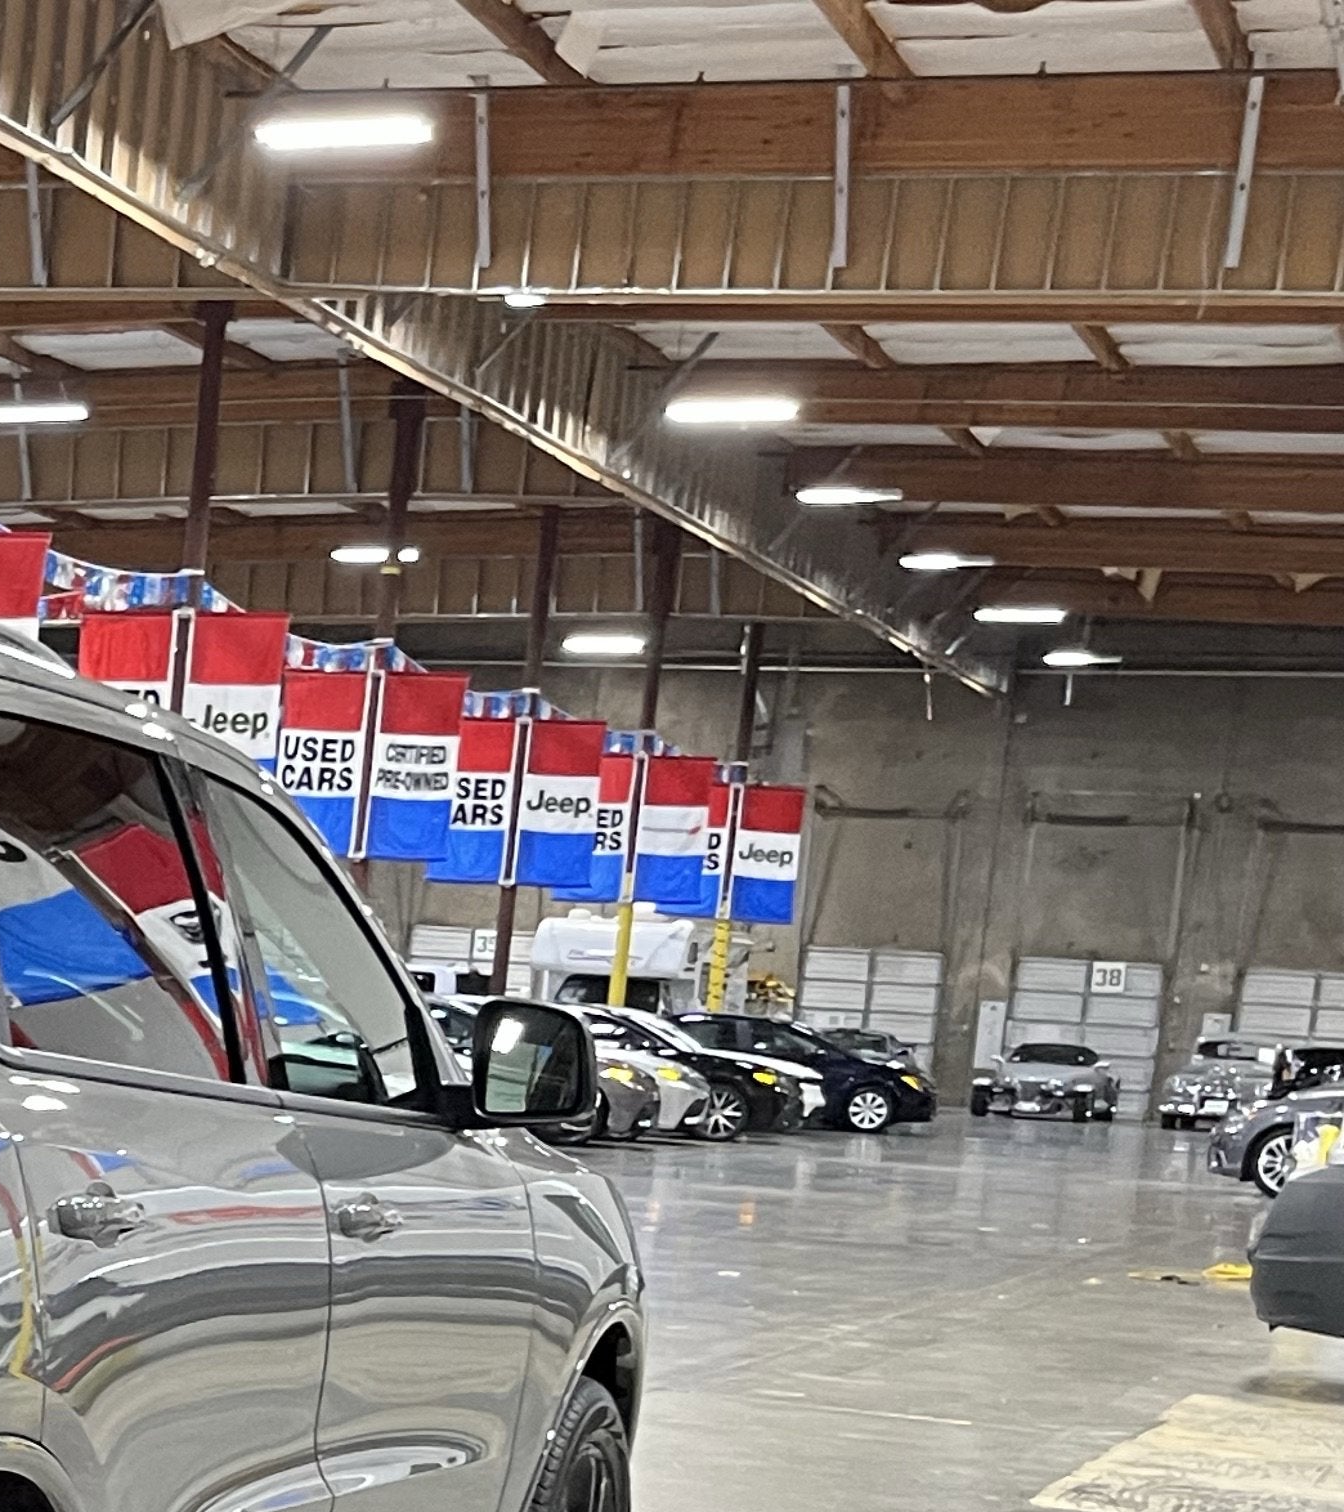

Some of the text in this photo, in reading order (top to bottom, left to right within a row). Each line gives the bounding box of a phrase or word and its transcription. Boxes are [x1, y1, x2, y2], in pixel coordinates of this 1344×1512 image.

[283, 735, 356, 763] USED
[281, 765, 354, 792] CARS
[456, 778, 507, 801] SED
[451, 803, 504, 826] ARS
[526, 789, 592, 818] Jeep
[597, 808, 624, 829] ED
[738, 843, 794, 868] Jeep
[1094, 968, 1122, 987] 38
